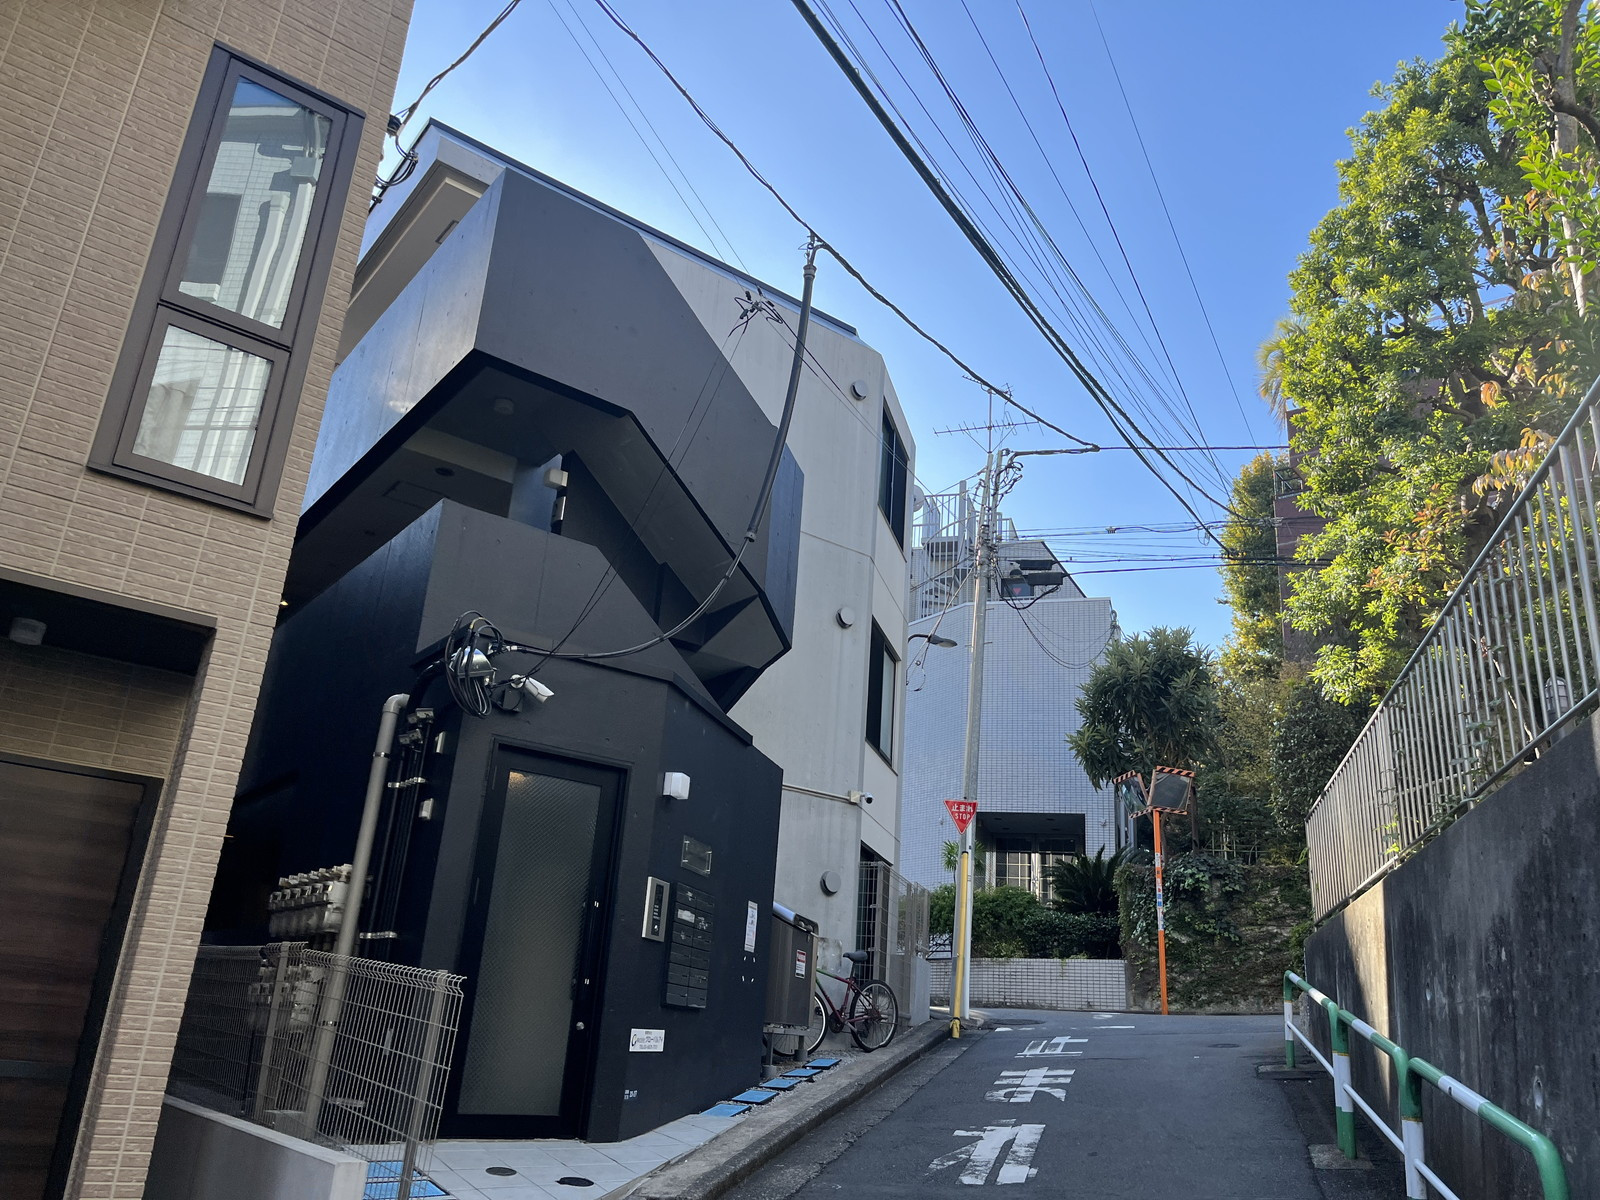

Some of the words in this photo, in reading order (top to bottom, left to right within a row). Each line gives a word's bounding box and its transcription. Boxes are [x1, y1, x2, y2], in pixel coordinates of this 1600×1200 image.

[952, 803, 973, 812] 止まれ
[925, 1036, 1089, 1185] 止まれ
